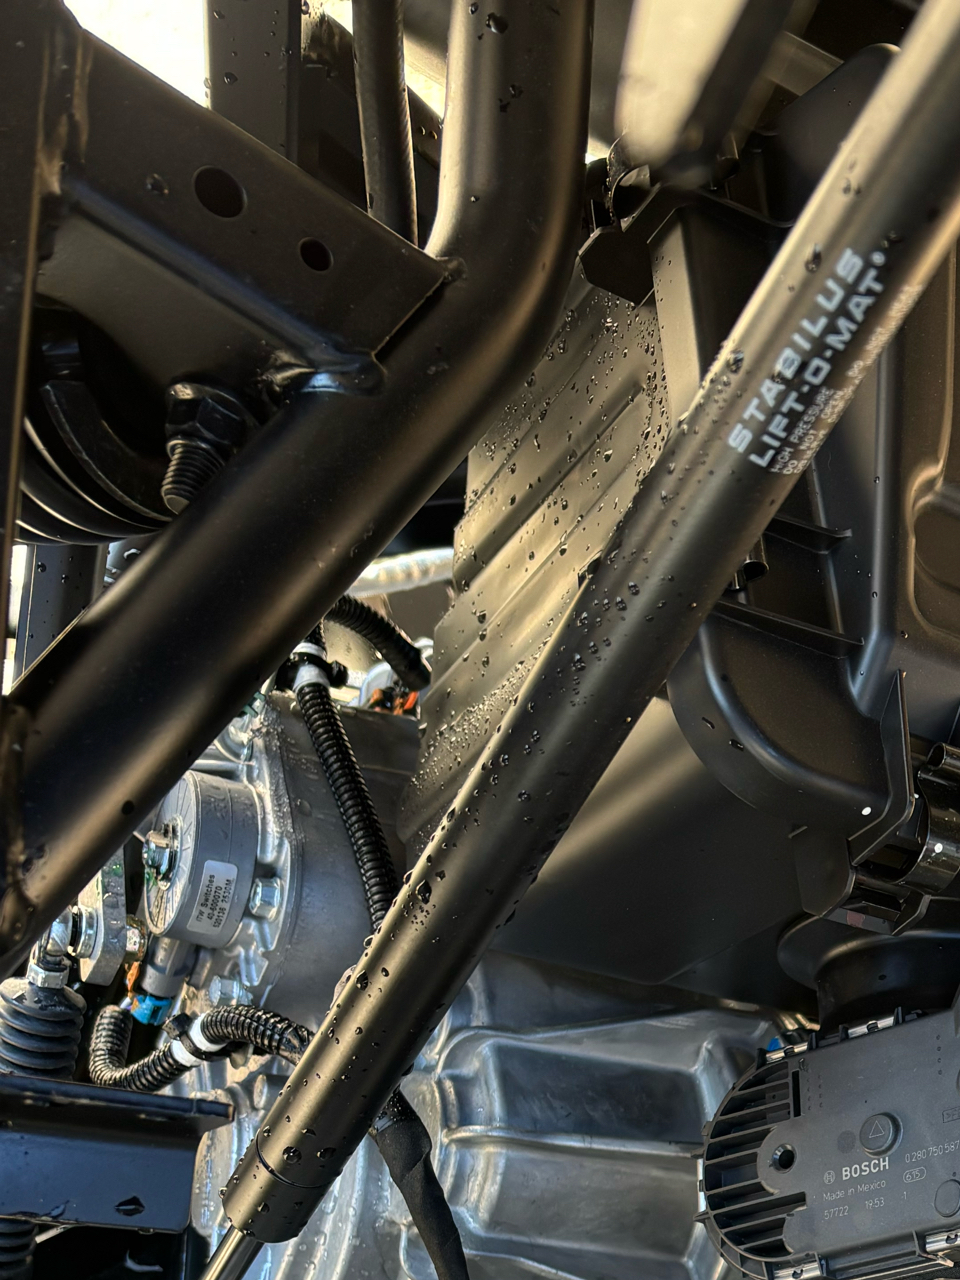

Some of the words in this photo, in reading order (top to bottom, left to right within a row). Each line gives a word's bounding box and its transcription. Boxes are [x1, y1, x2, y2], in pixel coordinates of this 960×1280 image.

[727, 247, 863, 453] STABILUS
[789, 386, 834, 444] PRESSURE
[200, 874, 215, 908] Switches
[842, 1157, 889, 1180] BOSCH
[823, 1191, 845, 1202] Made
[847, 1187, 855, 1196] in
[857, 1180, 887, 1193] Mexico
[824, 1205, 849, 1220] 57722
